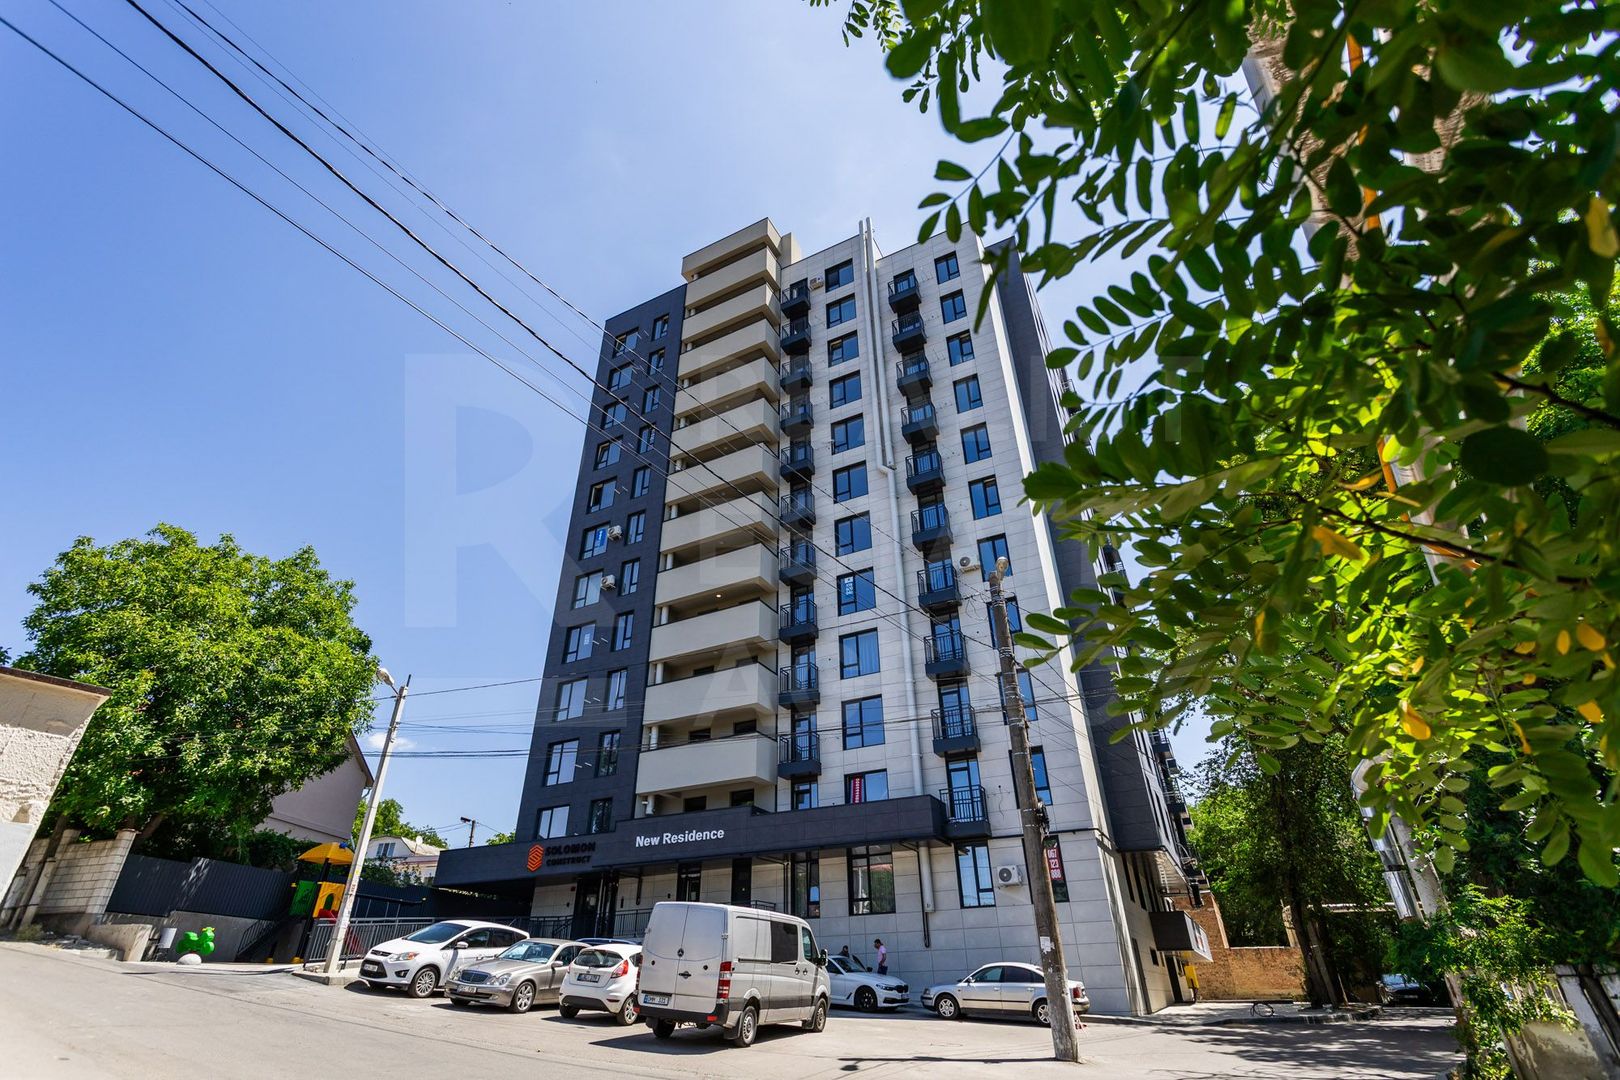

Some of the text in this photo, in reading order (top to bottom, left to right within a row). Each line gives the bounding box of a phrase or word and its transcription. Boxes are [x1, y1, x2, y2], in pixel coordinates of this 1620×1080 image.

[635, 829, 725, 848] New Residence
[545, 842, 596, 856] SOLOMON
[546, 855, 592, 867] CONSTRUCT
